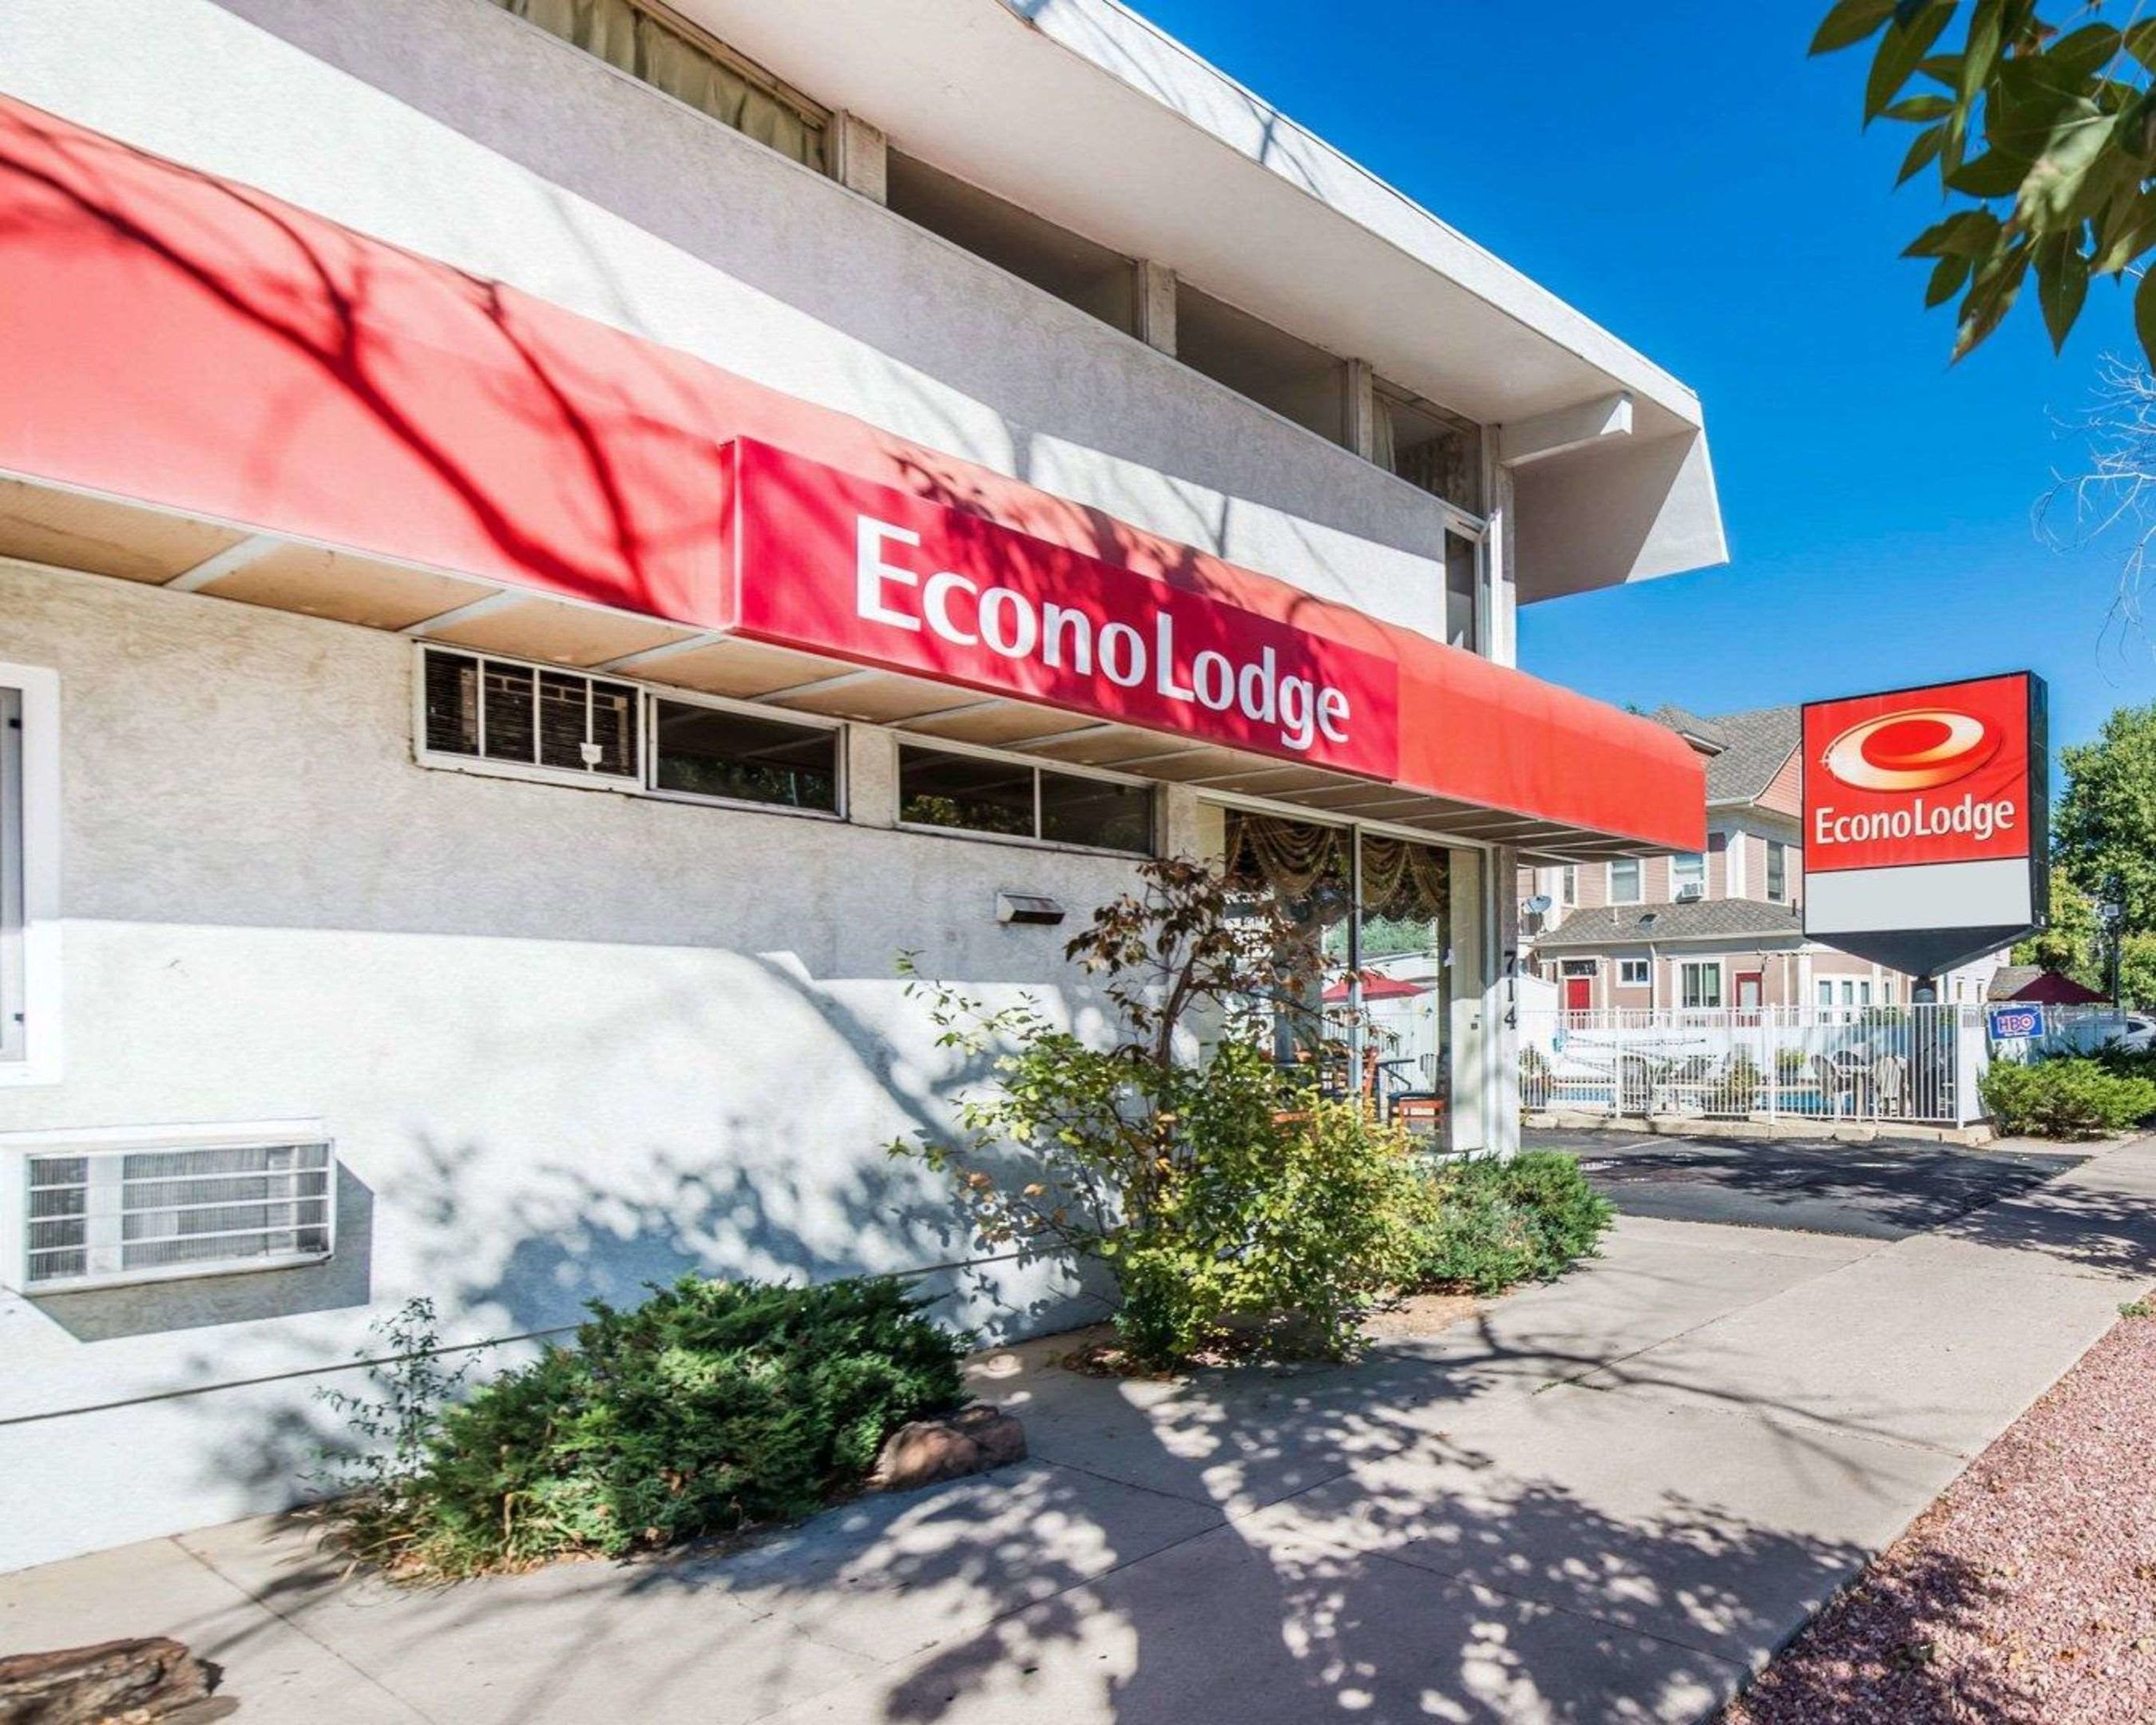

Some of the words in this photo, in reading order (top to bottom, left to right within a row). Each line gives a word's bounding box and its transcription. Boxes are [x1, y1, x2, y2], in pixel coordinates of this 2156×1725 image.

[856, 514, 1350, 751] EconoLodge
[1815, 793, 2015, 844] EconoLodge
[1504, 950, 1517, 1030] 714
[1998, 1013, 2035, 1033] HBO
